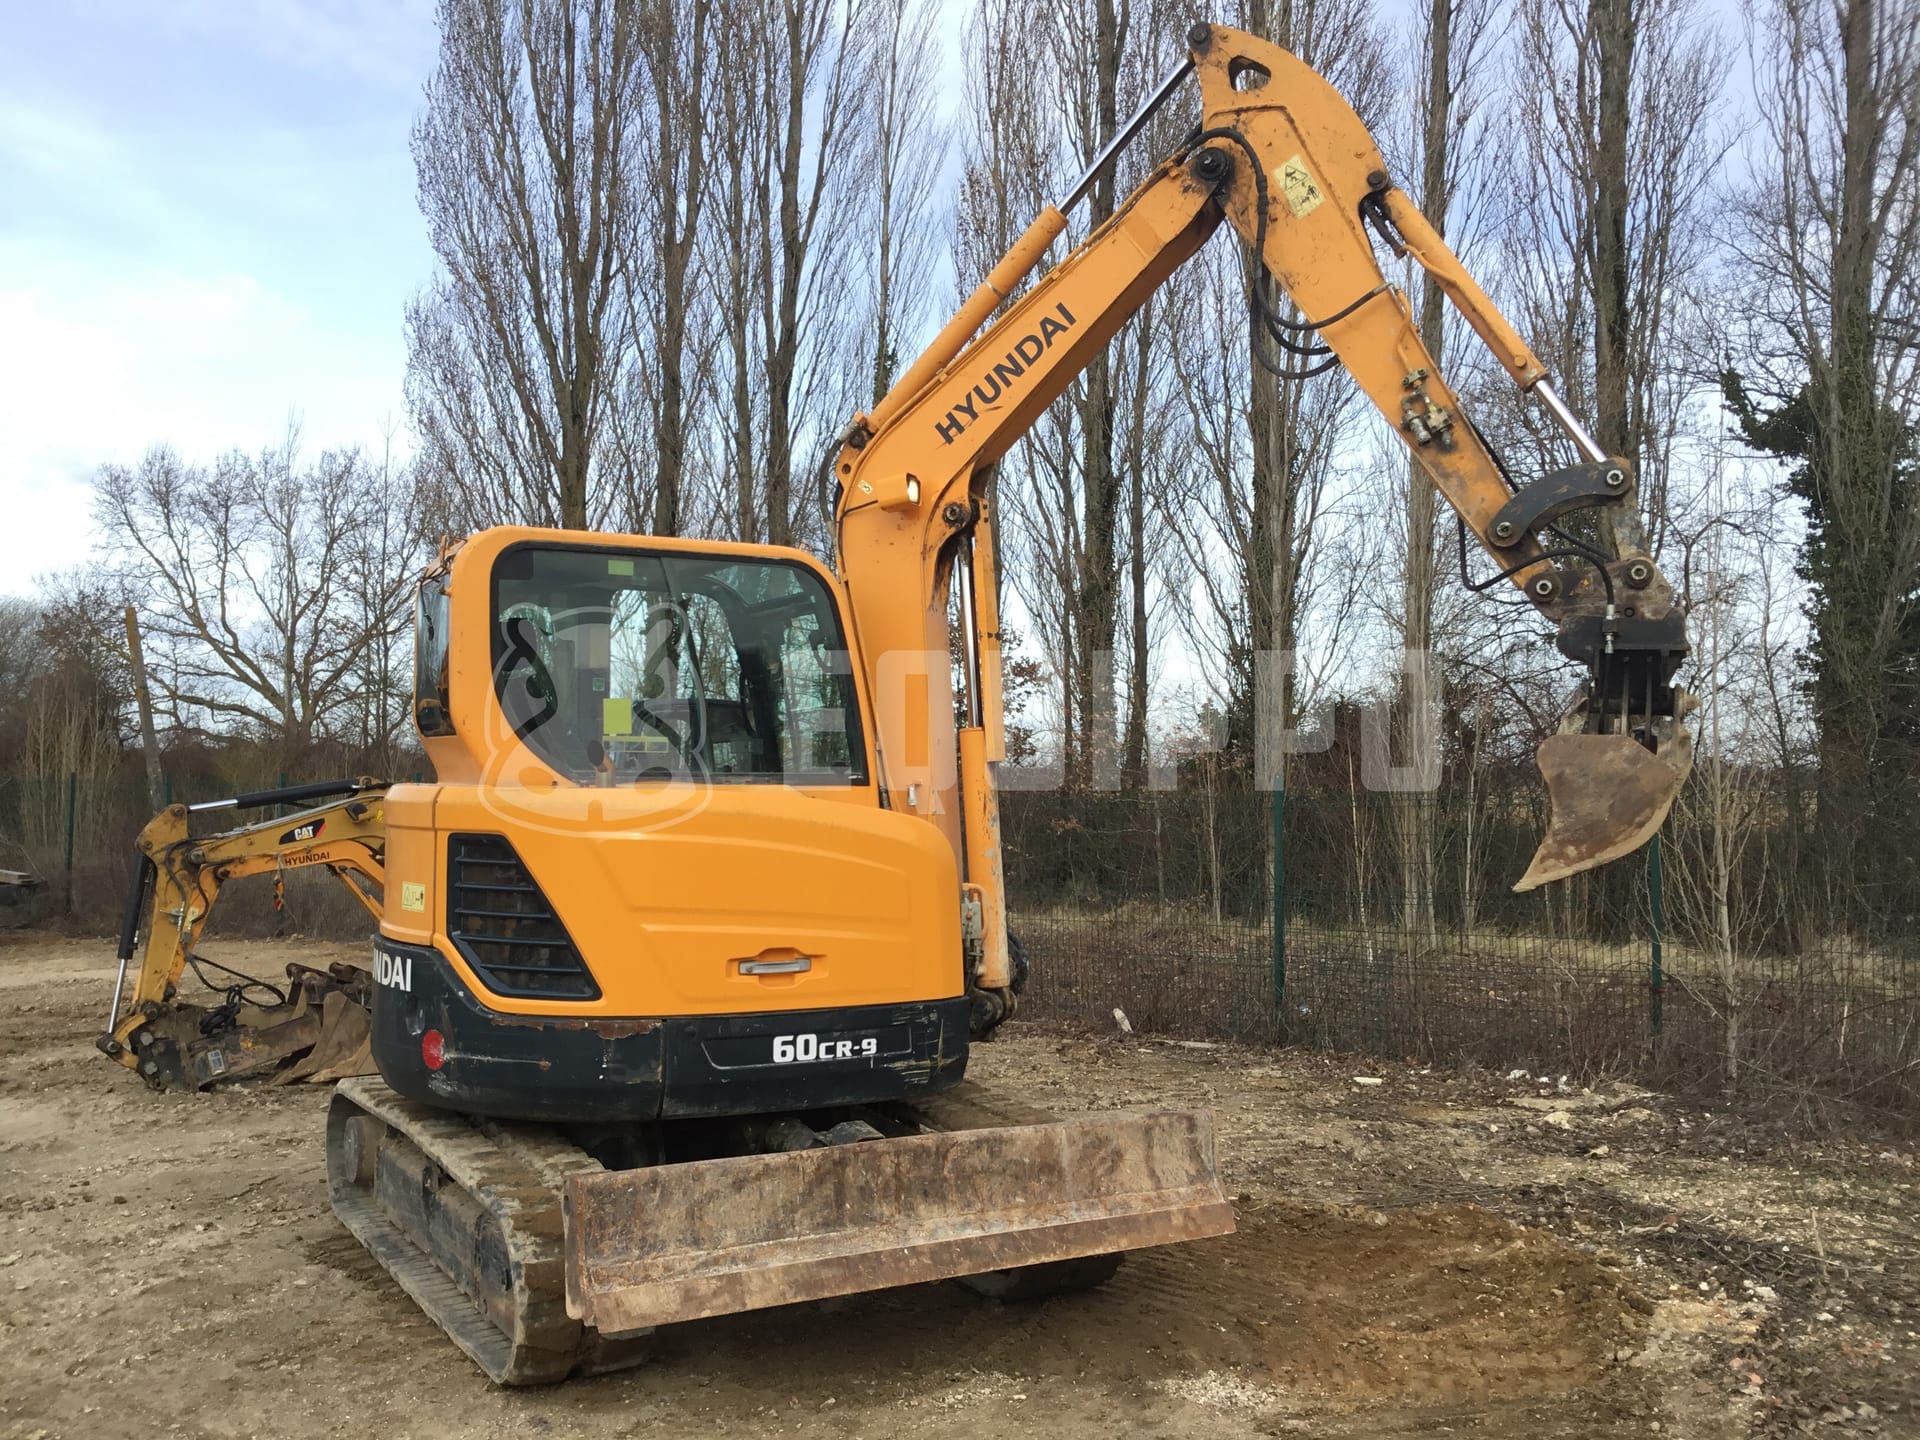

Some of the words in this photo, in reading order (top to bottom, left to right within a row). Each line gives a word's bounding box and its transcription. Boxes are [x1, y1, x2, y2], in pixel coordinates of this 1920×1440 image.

[934, 302, 1077, 445] HYUNDAI
[294, 826, 313, 840] CAT
[285, 852, 330, 866] HYUNDAI
[773, 1033, 877, 1063] 60CR-9
